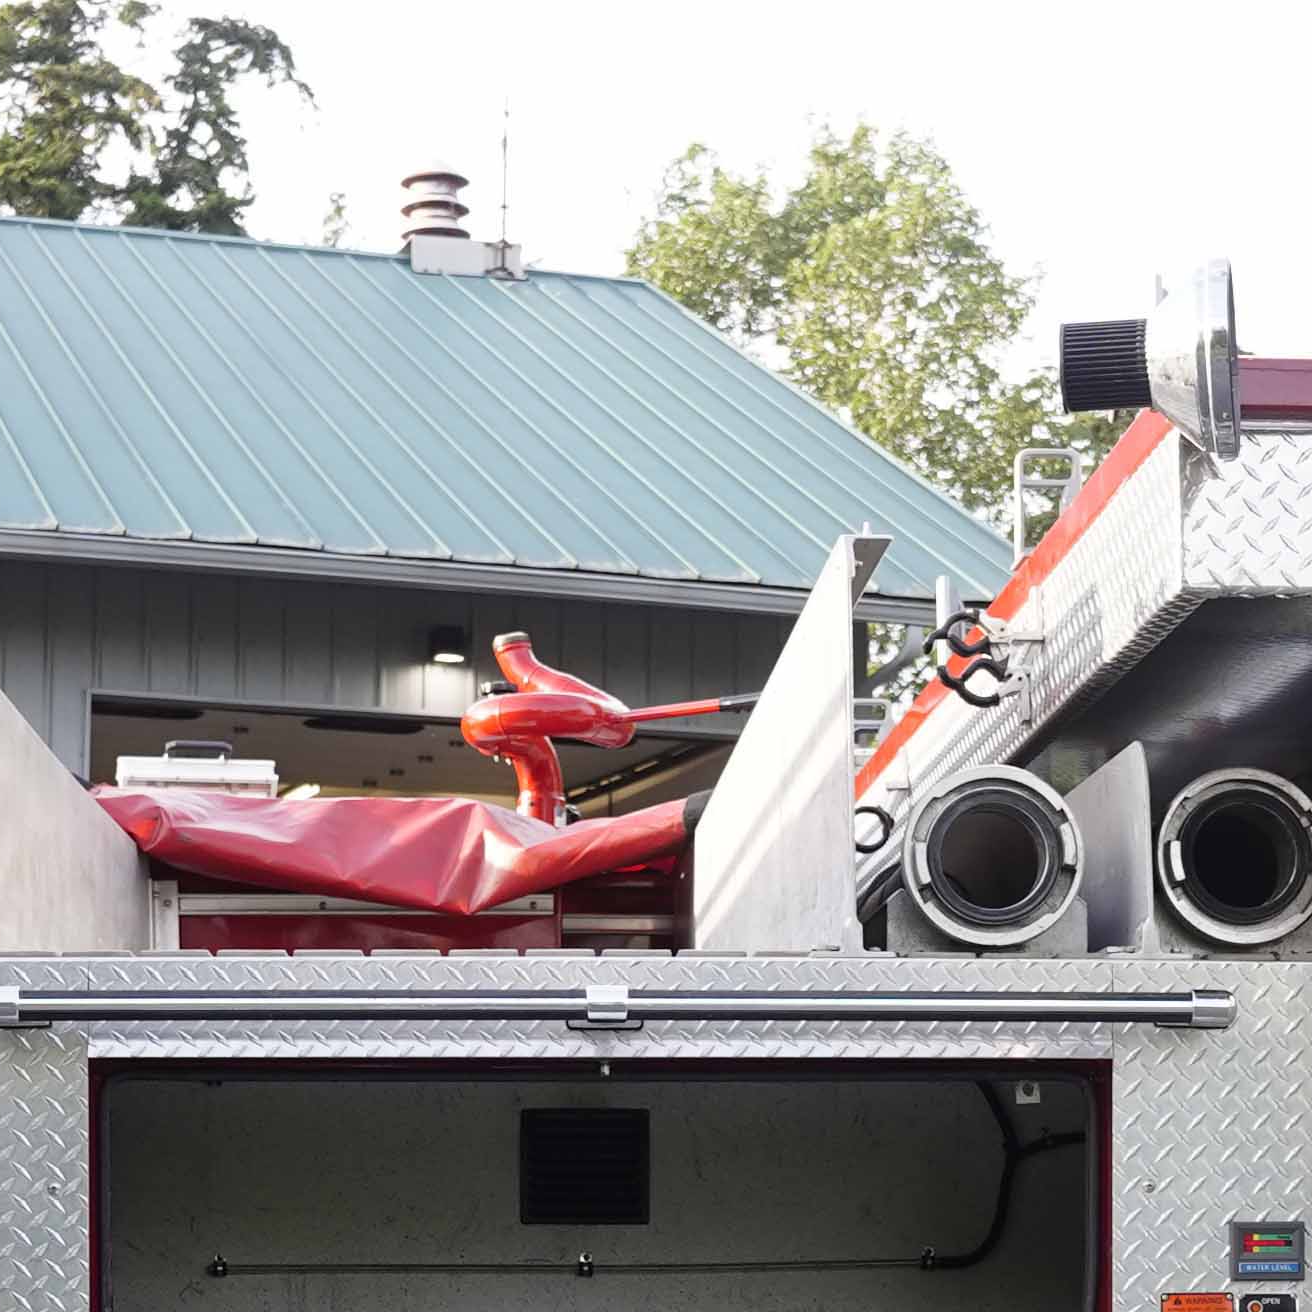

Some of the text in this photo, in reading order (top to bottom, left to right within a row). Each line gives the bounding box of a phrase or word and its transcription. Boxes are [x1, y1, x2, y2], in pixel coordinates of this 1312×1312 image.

[1246, 1263, 1293, 1272] WATER LEVEL
[1261, 1297, 1281, 1305] OPEN
